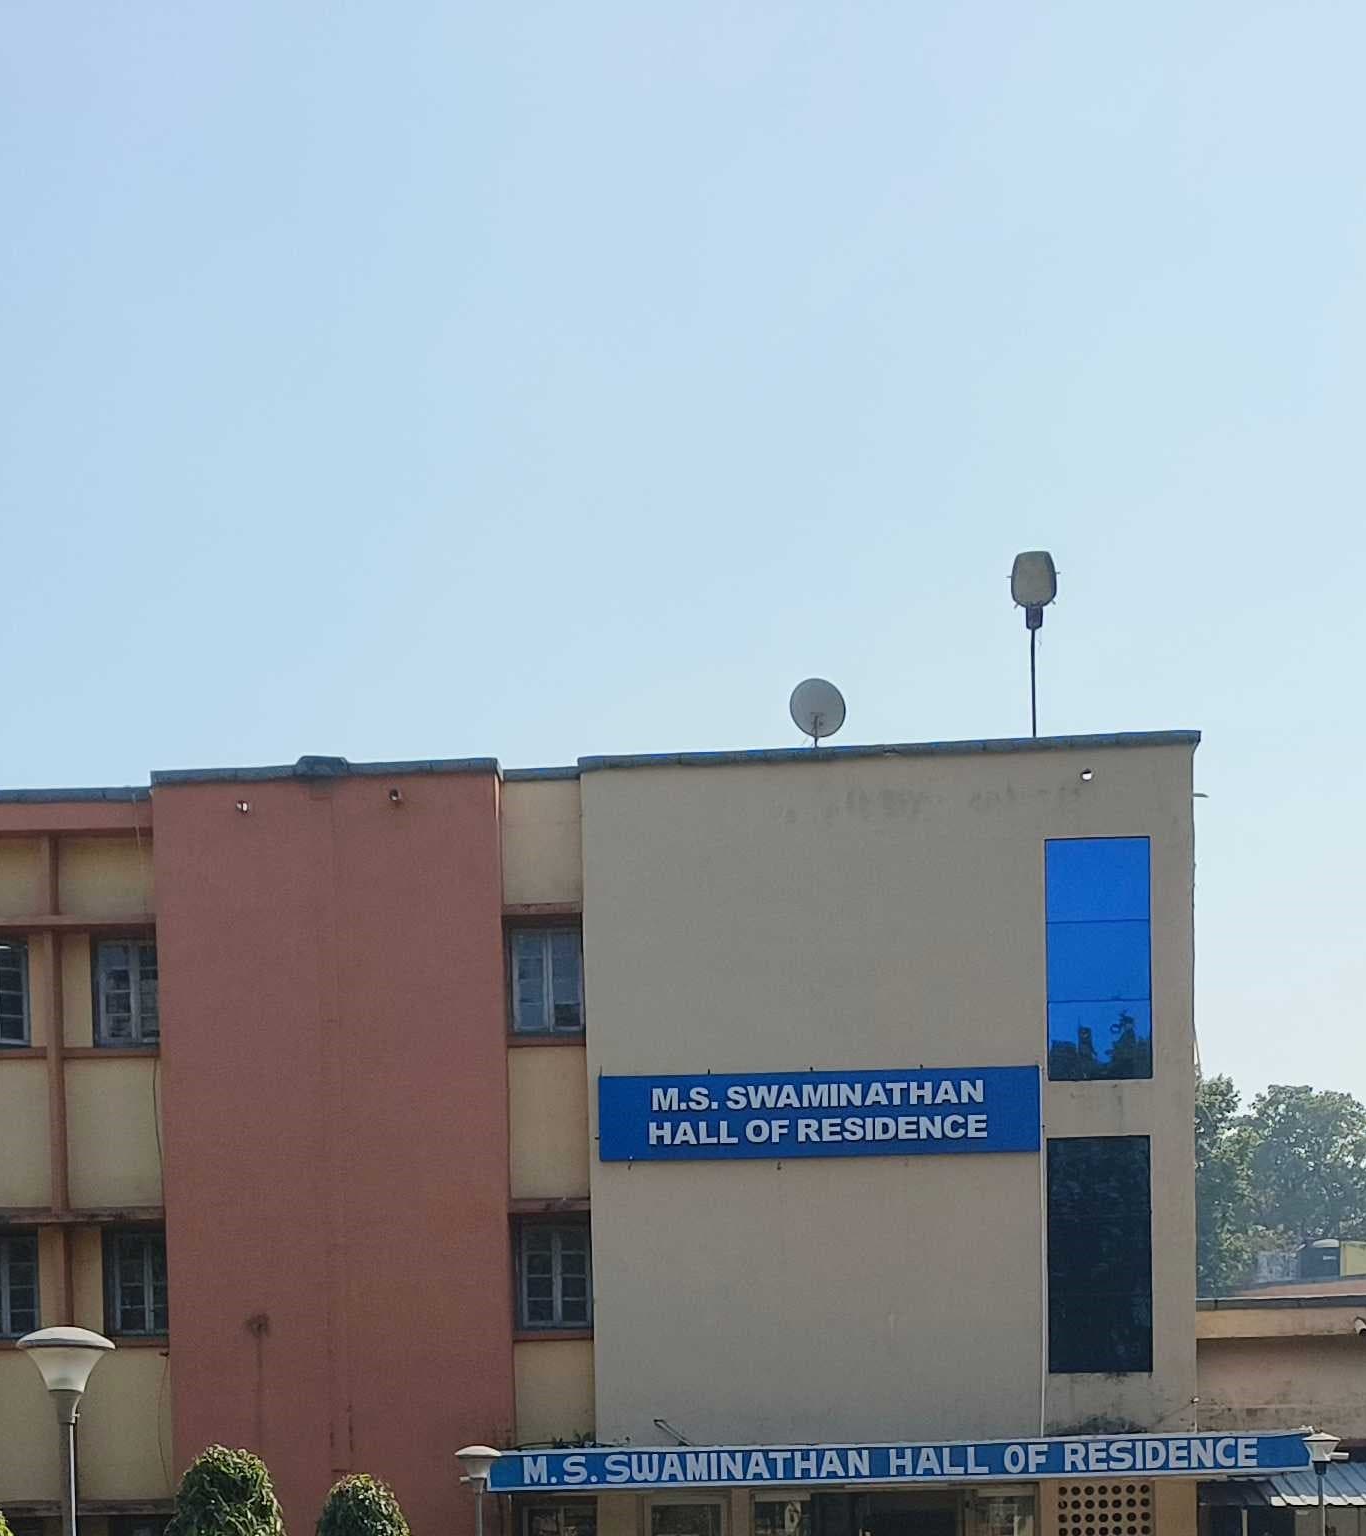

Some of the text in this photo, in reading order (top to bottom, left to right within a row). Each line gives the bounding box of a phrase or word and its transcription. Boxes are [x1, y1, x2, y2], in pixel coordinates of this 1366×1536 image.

[651, 1079, 984, 1111] M.S. SWAMINATHAN
[648, 1114, 988, 1145] HALL OF RESIDENCE
[888, 1446, 990, 1475] HALL
[1003, 1444, 1049, 1474] OF
[1063, 1437, 1259, 1471] RESIDENCE
